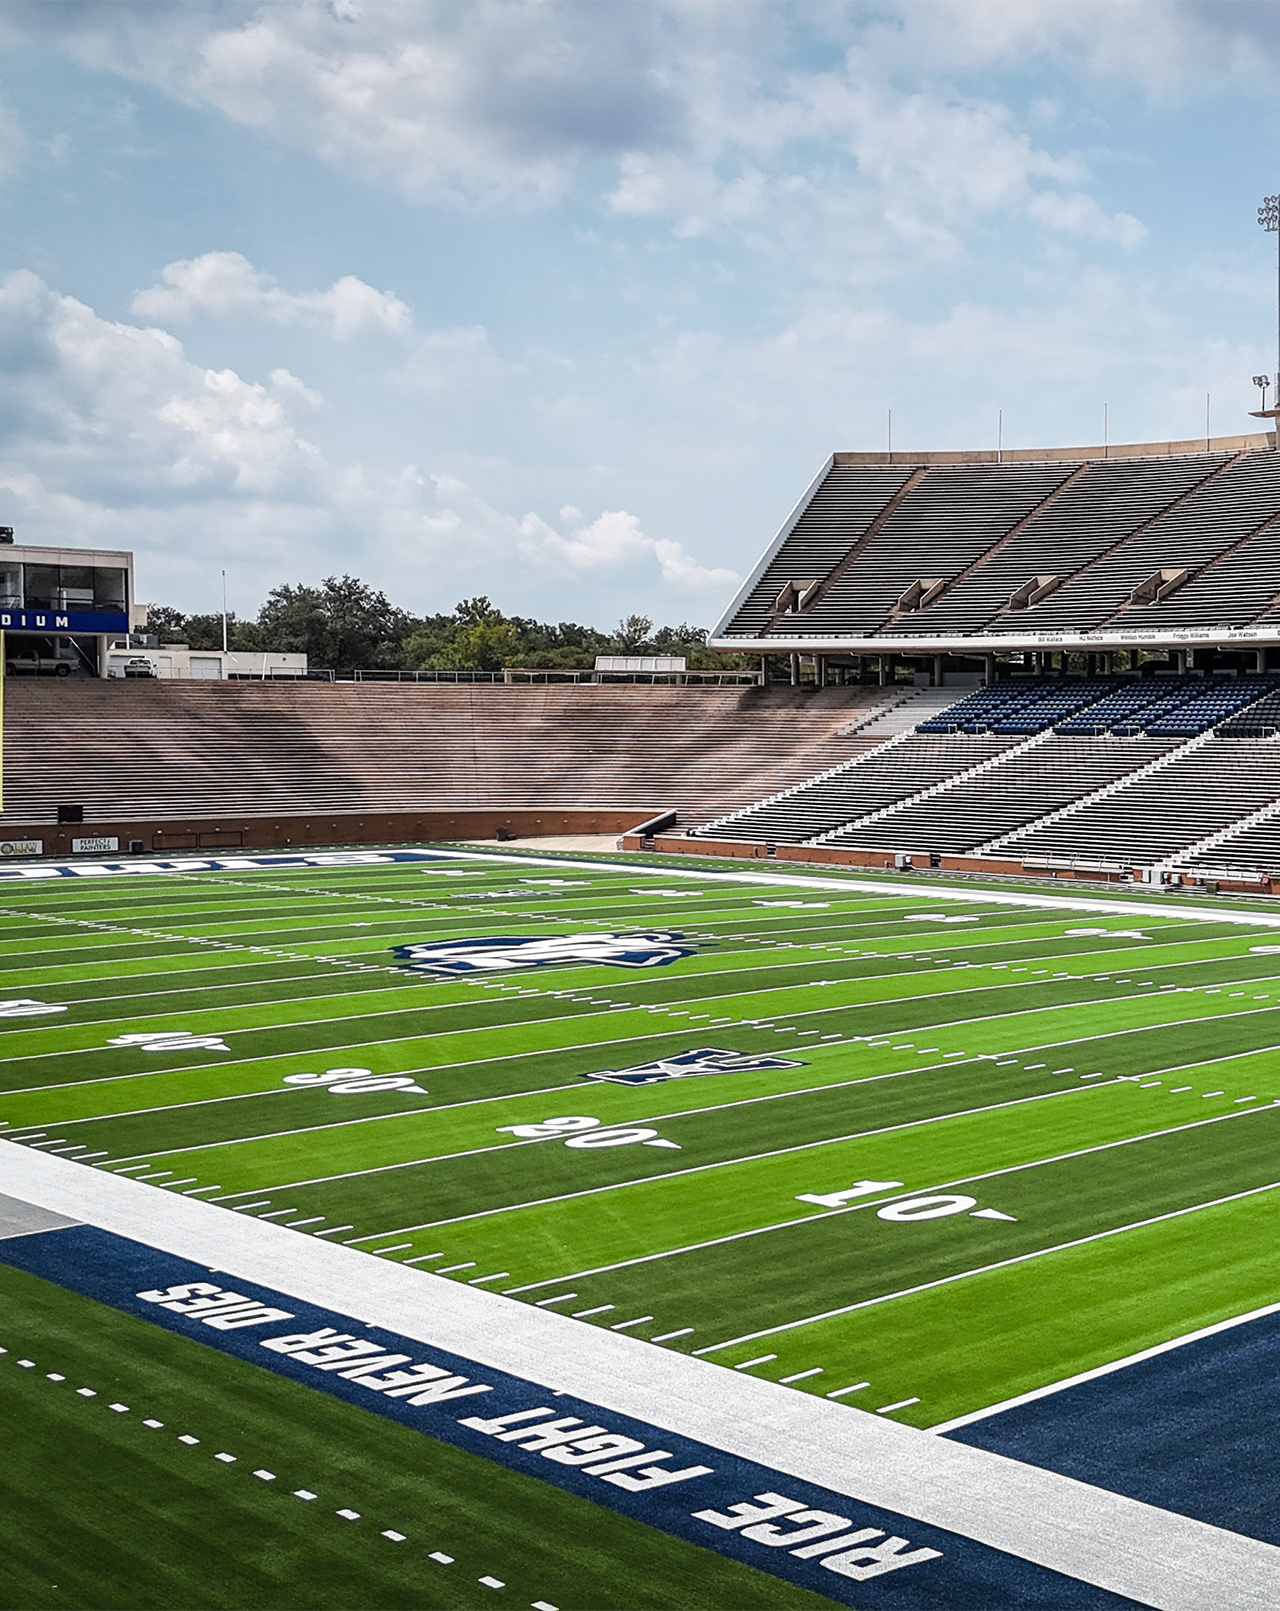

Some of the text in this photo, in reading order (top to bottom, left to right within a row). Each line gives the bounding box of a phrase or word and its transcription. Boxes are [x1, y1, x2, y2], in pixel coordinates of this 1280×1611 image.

[496, 1115, 659, 1149] 20
[794, 1179, 978, 1222] 10
[135, 1281, 945, 1582] RICE FIGHT NEVER DIES
